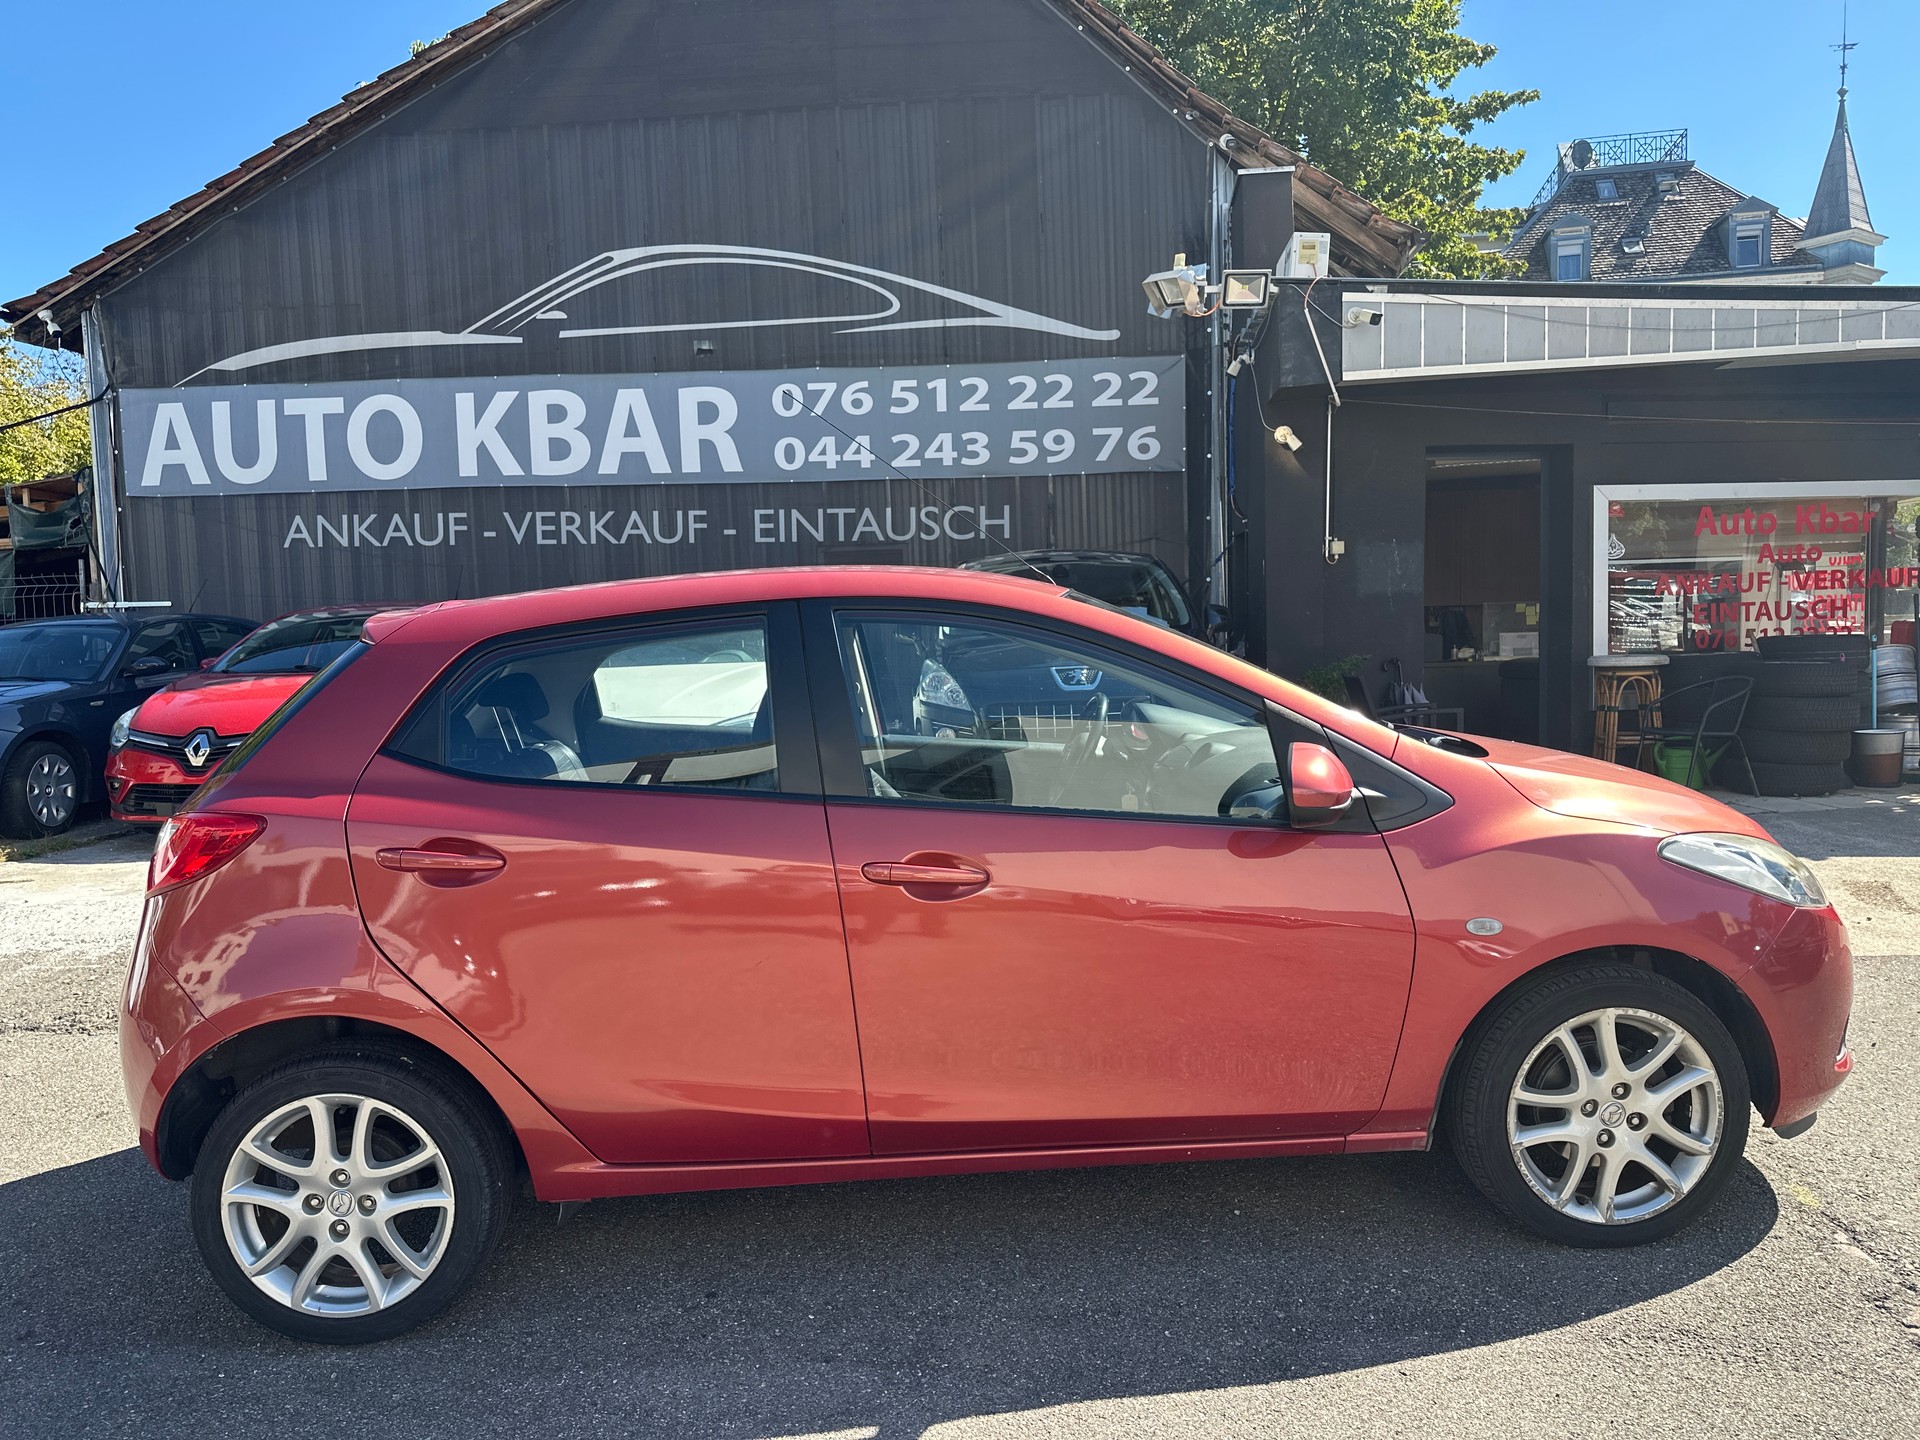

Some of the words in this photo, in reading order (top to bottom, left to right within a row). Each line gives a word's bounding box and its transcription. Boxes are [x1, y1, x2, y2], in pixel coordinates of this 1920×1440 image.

[771, 380, 874, 418] 076
[889, 377, 990, 415] 512
[1007, 373, 1074, 411] 22
[1091, 370, 1159, 407] 22
[141, 393, 423, 487] AUTO
[455, 386, 744, 477] KBAR
[774, 435, 876, 471] 044
[891, 431, 991, 468] 243
[1008, 428, 1076, 464] 59
[1092, 425, 1161, 462] 76
[284, 513, 468, 548] ANKAUF
[503, 510, 708, 545] VERKAUF
[754, 505, 1010, 543] EINTAUSCH
[1694, 506, 1777, 536] Auto
[1795, 502, 1876, 534] Kbar
[1757, 543, 1823, 564] Auto
[1654, 571, 1771, 596] ANKAUF
[1693, 599, 1848, 624] EINTAUSCH
[1695, 628, 1739, 649] 076
